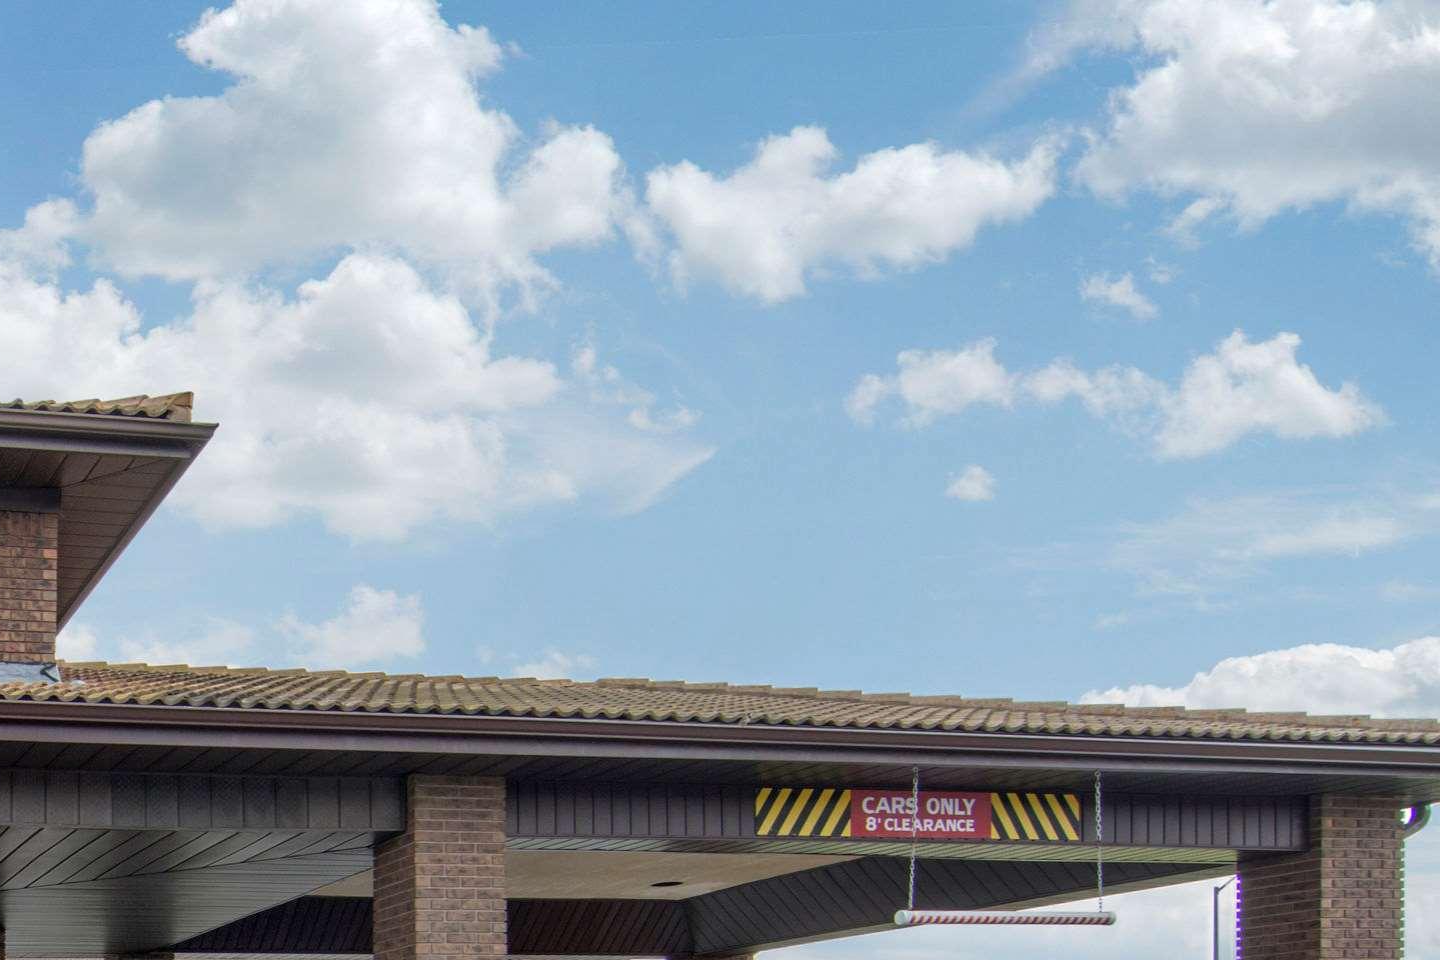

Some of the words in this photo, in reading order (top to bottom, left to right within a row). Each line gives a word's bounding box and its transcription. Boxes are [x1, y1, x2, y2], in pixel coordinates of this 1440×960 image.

[862, 797, 917, 814] CARS
[926, 798, 976, 815] ONLY
[865, 817, 881, 832] 8'
[884, 818, 976, 832] CLEARANCE
